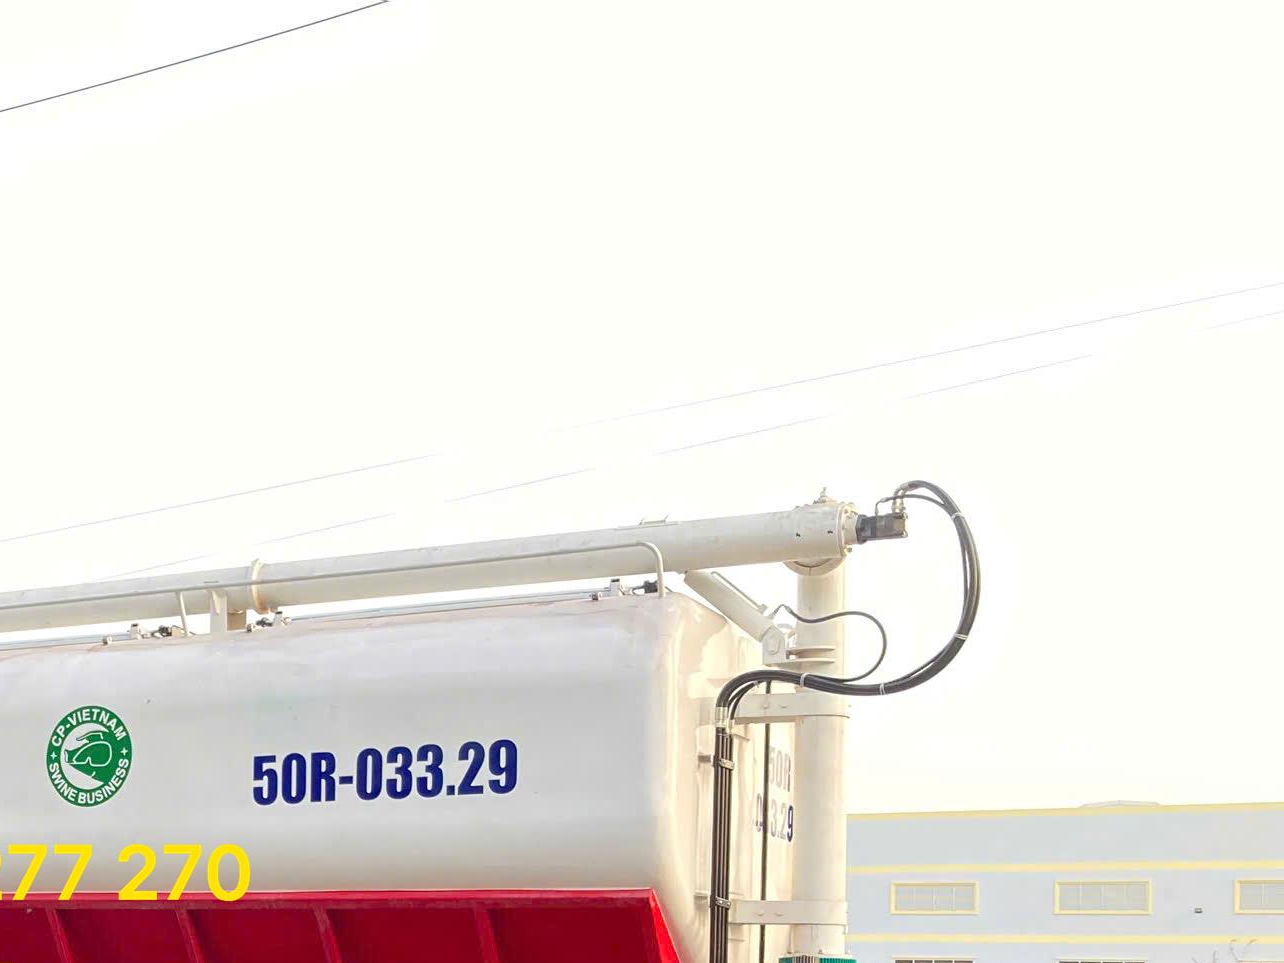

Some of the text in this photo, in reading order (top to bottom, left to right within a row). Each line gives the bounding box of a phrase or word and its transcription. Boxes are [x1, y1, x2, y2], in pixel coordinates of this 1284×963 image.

[51, 708, 127, 747] CP-VIETNAM
[49, 758, 129, 804] SWINE BUSINESS
[252, 739, 518, 806] 50R-033.29
[755, 792, 794, 842] 03.29
